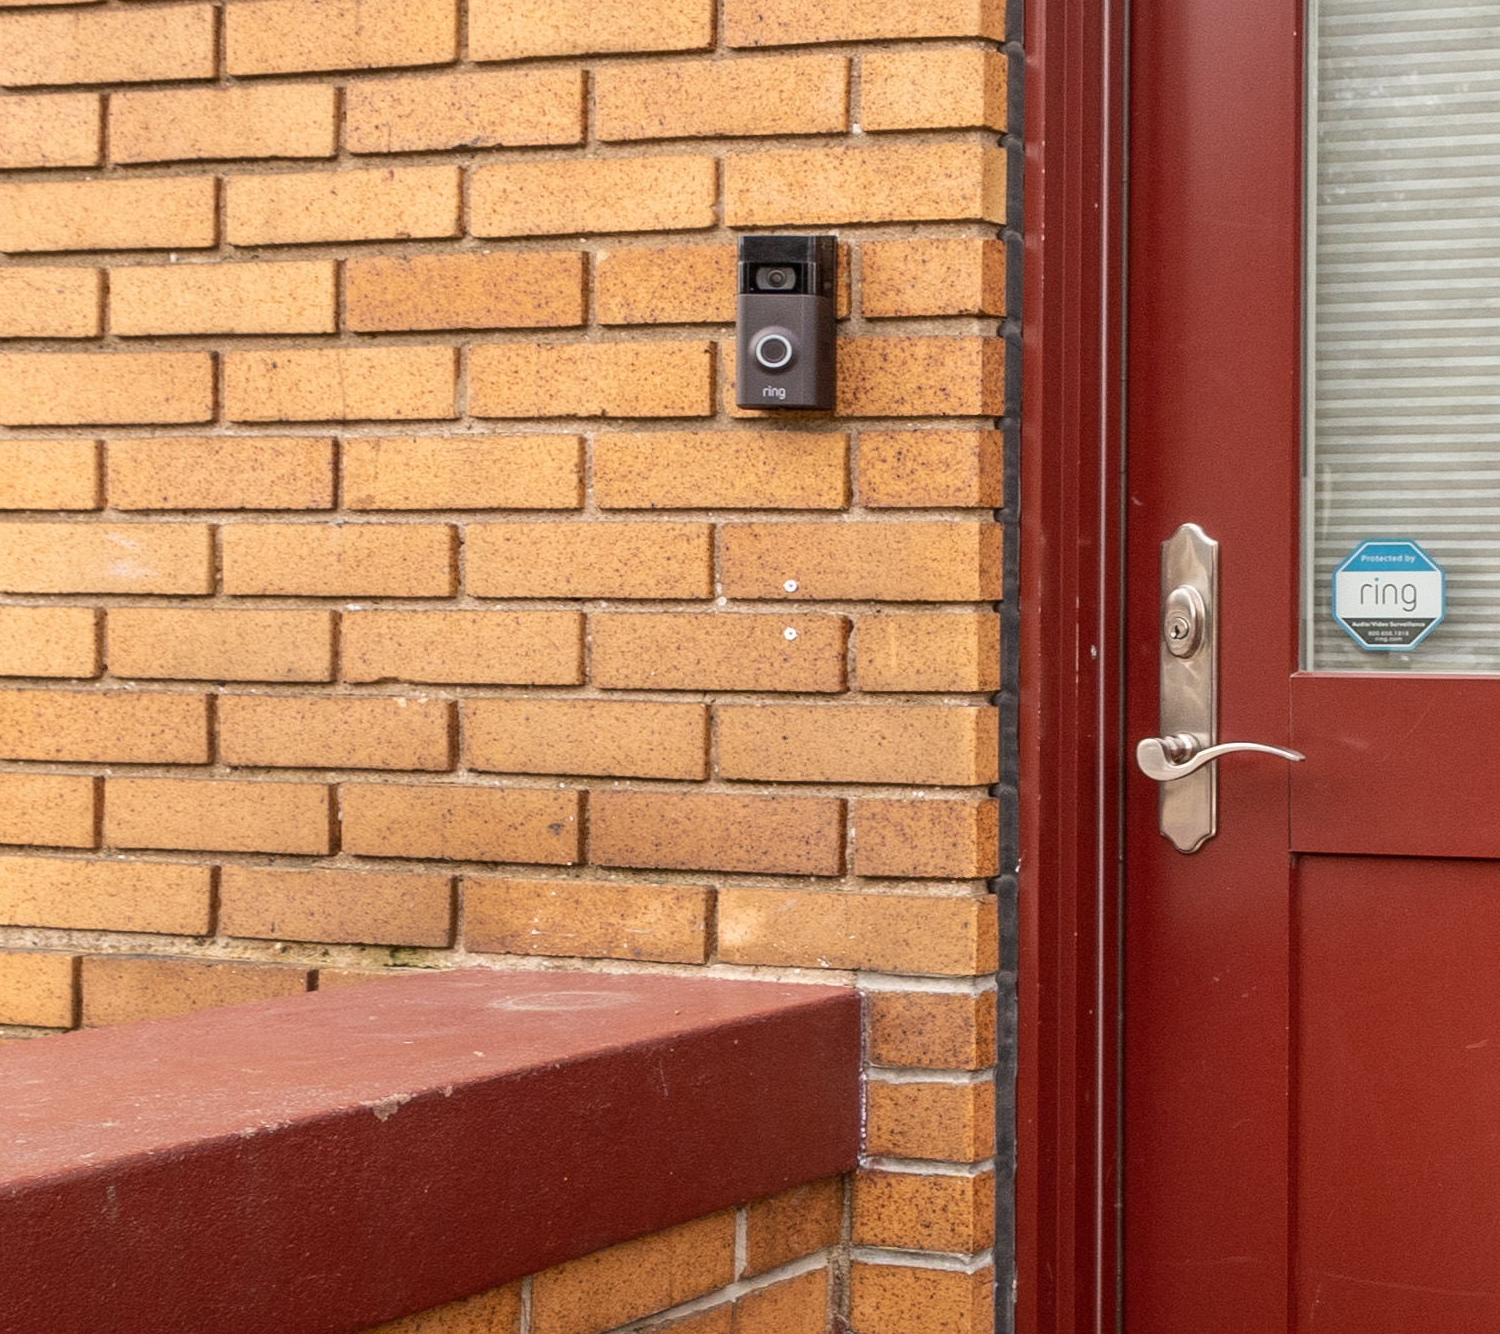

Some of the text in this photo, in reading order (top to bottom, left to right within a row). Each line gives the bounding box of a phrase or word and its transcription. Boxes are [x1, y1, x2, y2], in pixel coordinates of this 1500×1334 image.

[763, 385, 786, 400] ring
[1404, 555, 1416, 563] by
[1360, 577, 1417, 612] ring
